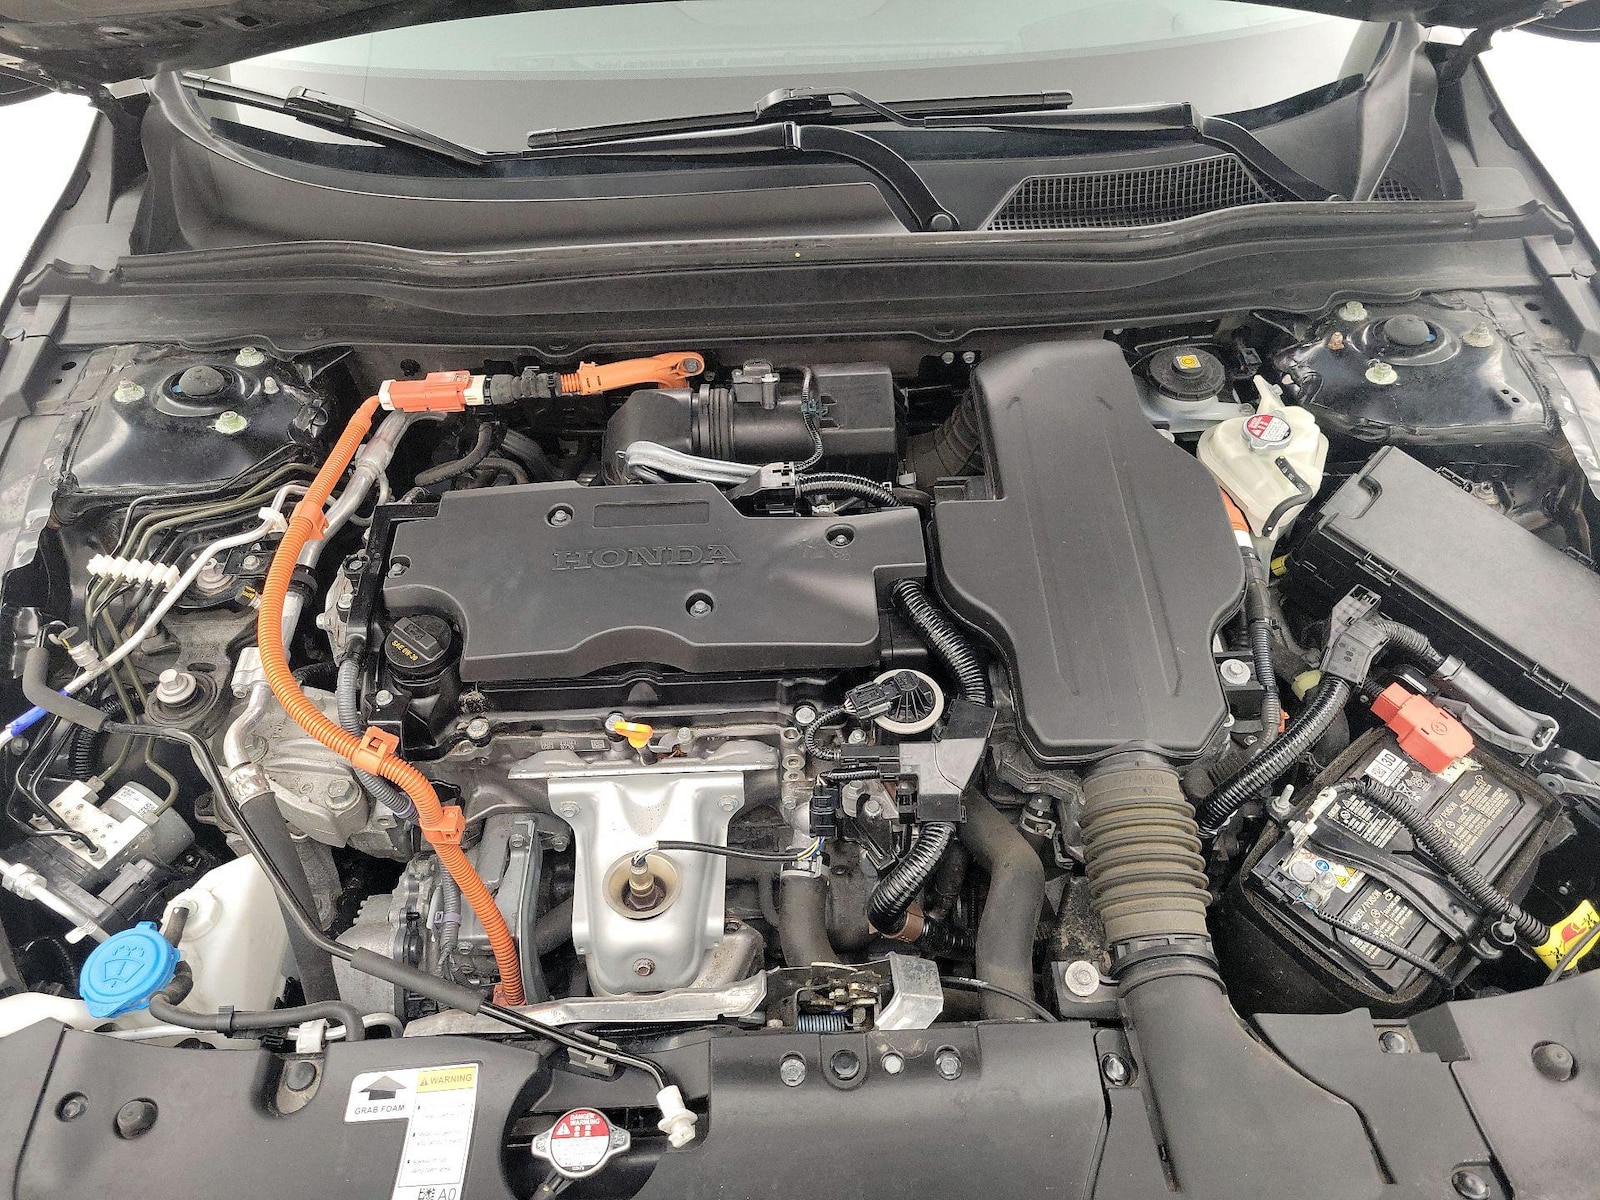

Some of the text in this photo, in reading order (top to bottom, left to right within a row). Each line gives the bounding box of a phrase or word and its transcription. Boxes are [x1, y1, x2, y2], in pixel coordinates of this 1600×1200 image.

[551, 544, 741, 571] HONDA
[391, 640, 419, 662] SAE 0W-20
[1380, 752, 1398, 767] 3D
[430, 1072, 473, 1085] WARNING
[354, 1103, 406, 1115] GRAB FOAM
[570, 1112, 595, 1120] DANGER
[570, 1117, 600, 1126] WARNING
